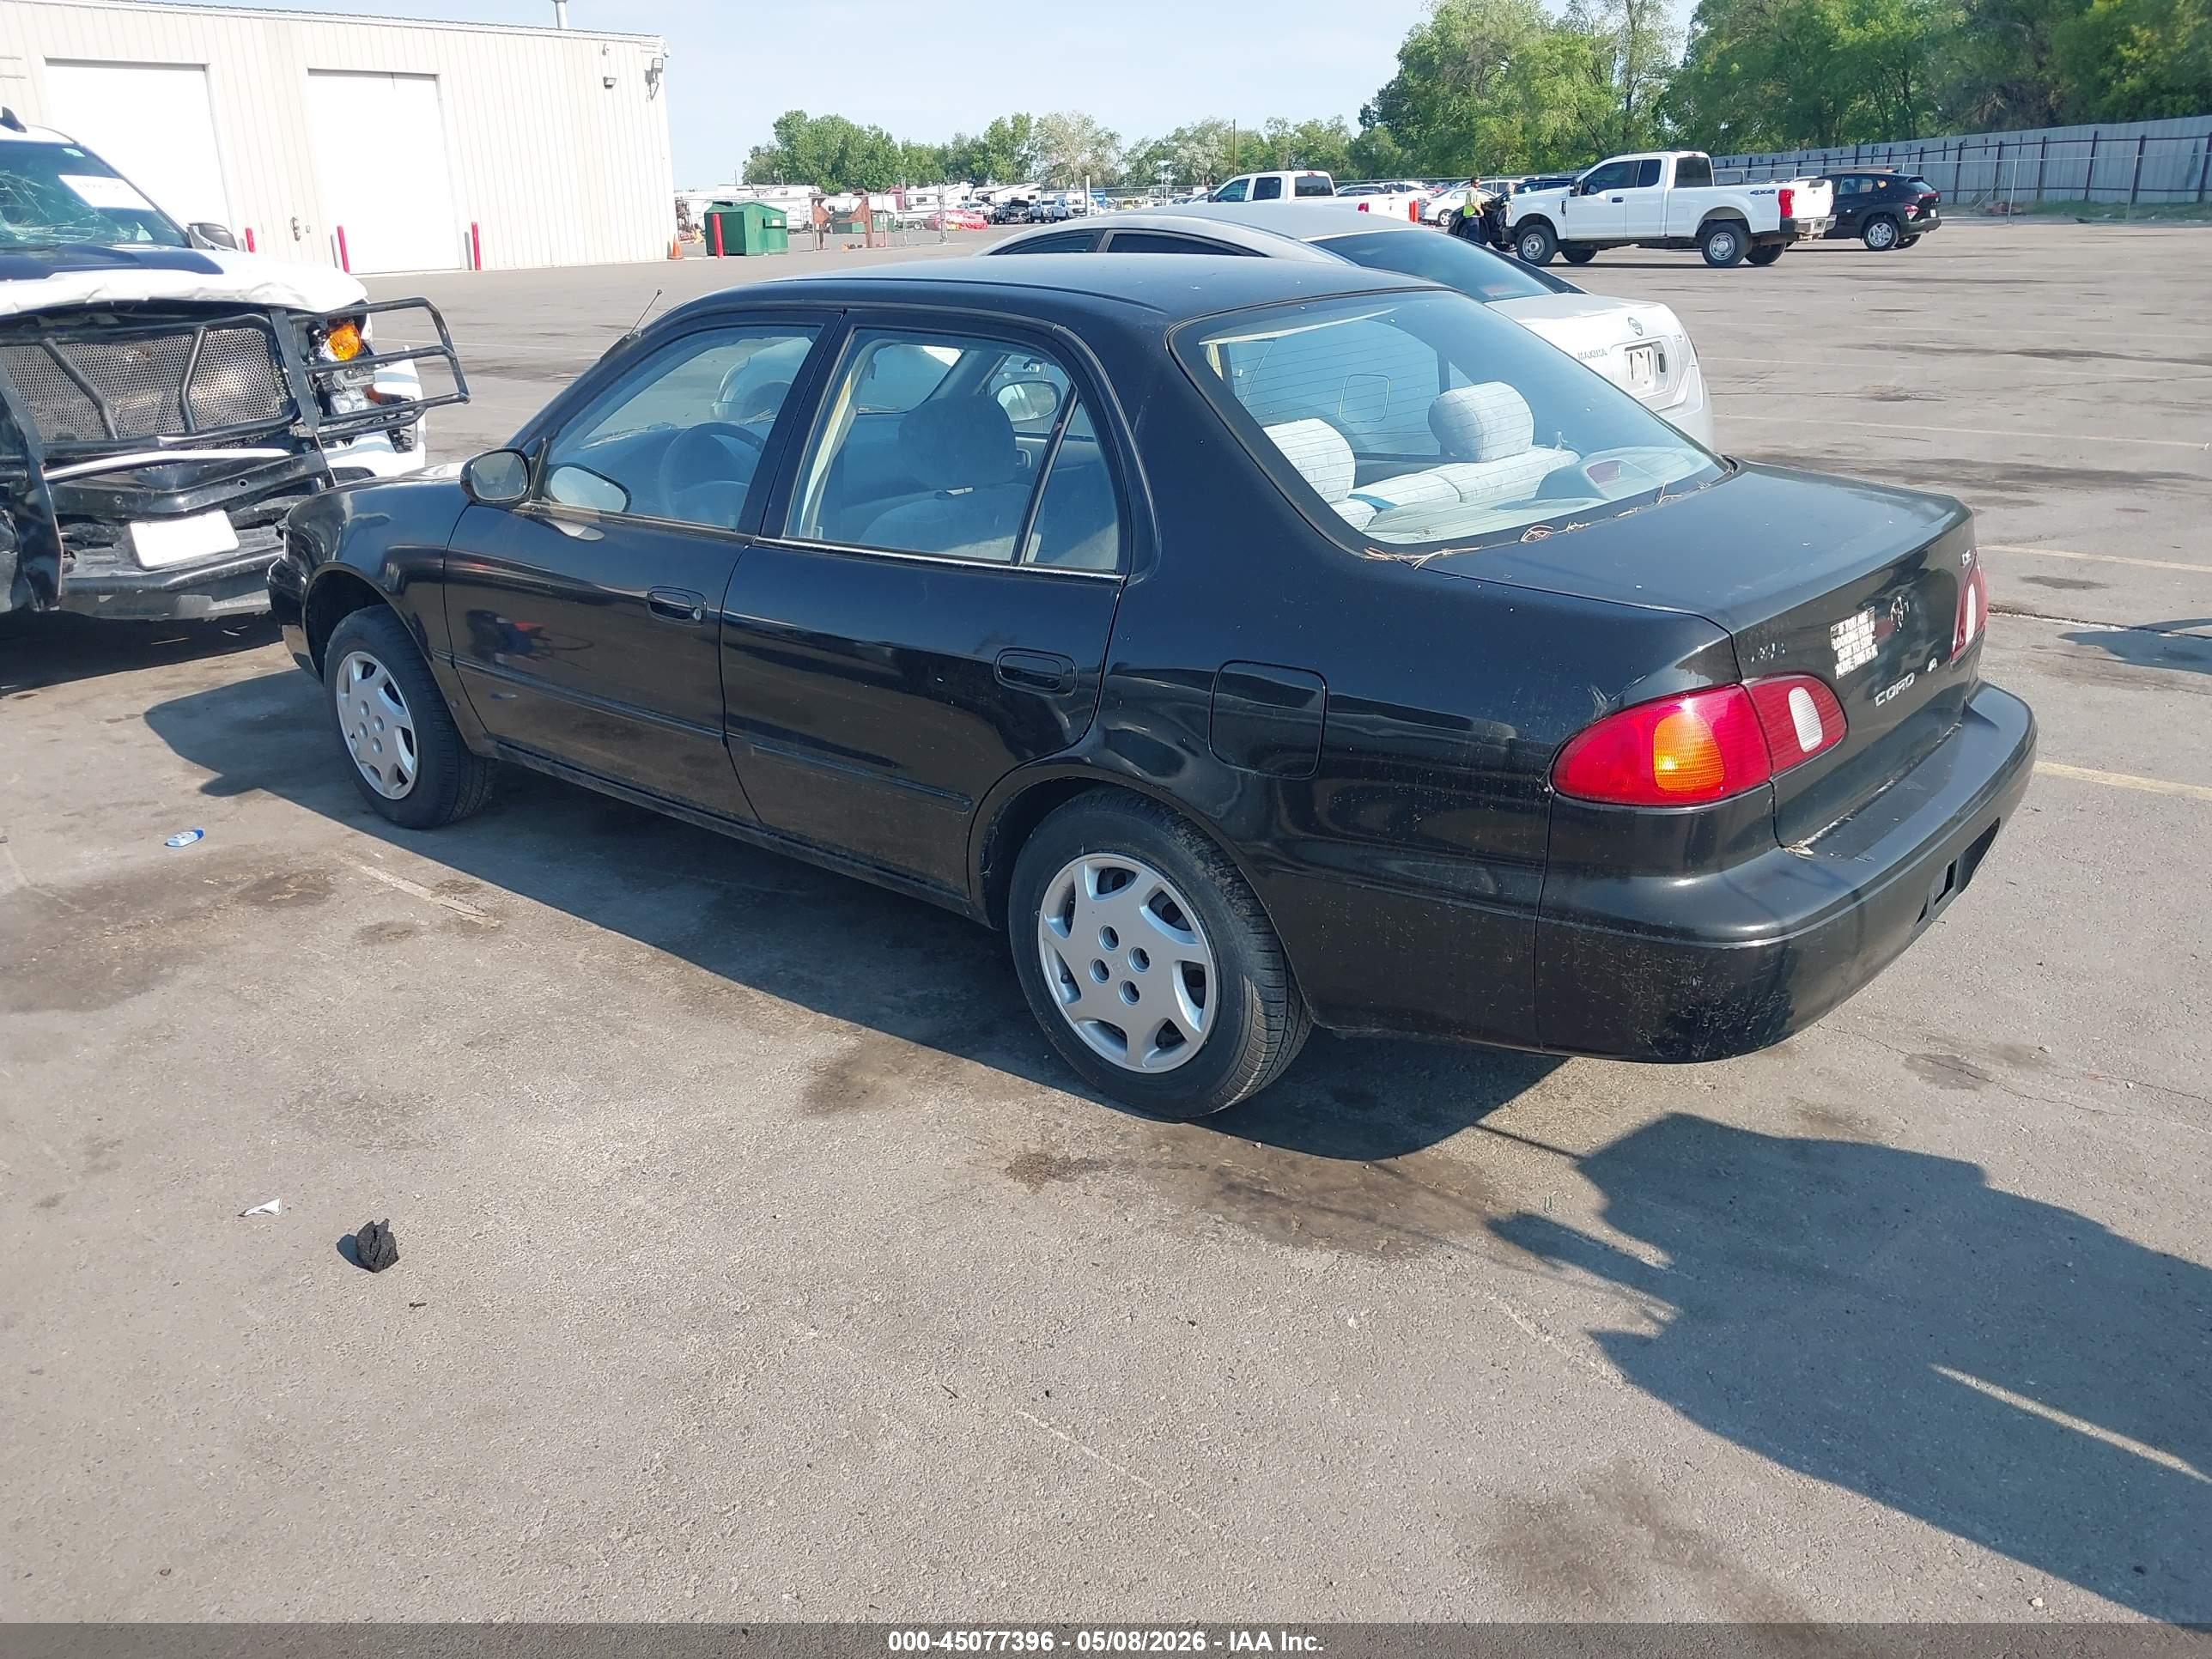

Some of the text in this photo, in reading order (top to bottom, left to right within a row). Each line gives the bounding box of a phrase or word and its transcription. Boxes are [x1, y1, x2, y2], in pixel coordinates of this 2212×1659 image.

[1844, 616, 1856, 632] YOU
[1856, 610, 1868, 627] ARE
[1832, 627, 1858, 651] LOOKING
[1837, 643, 1851, 662] SIGN
[1851, 639, 1860, 654] TO
